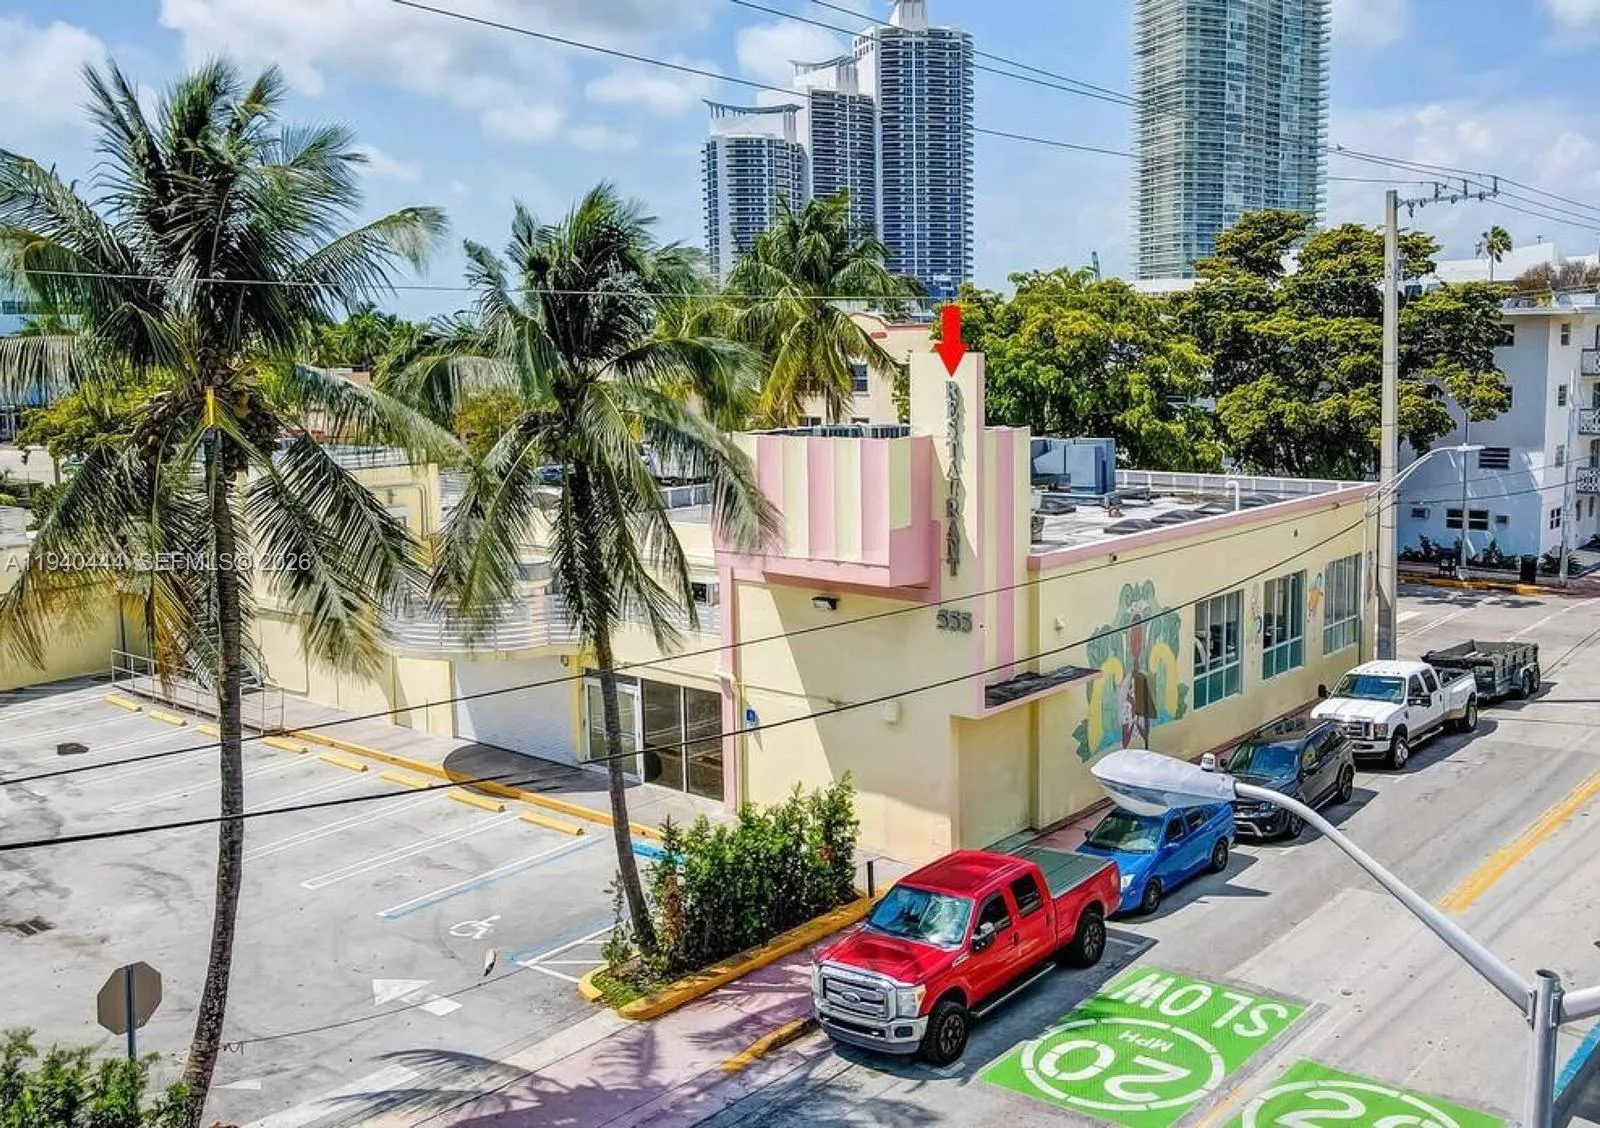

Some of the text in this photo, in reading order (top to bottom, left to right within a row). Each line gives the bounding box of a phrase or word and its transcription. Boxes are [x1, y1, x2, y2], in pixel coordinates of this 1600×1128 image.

[936, 609, 972, 633] 555
[1109, 973, 1288, 1037] SLOW
[1118, 1030, 1174, 1053] MPH
[1038, 1040, 1192, 1104] 20
